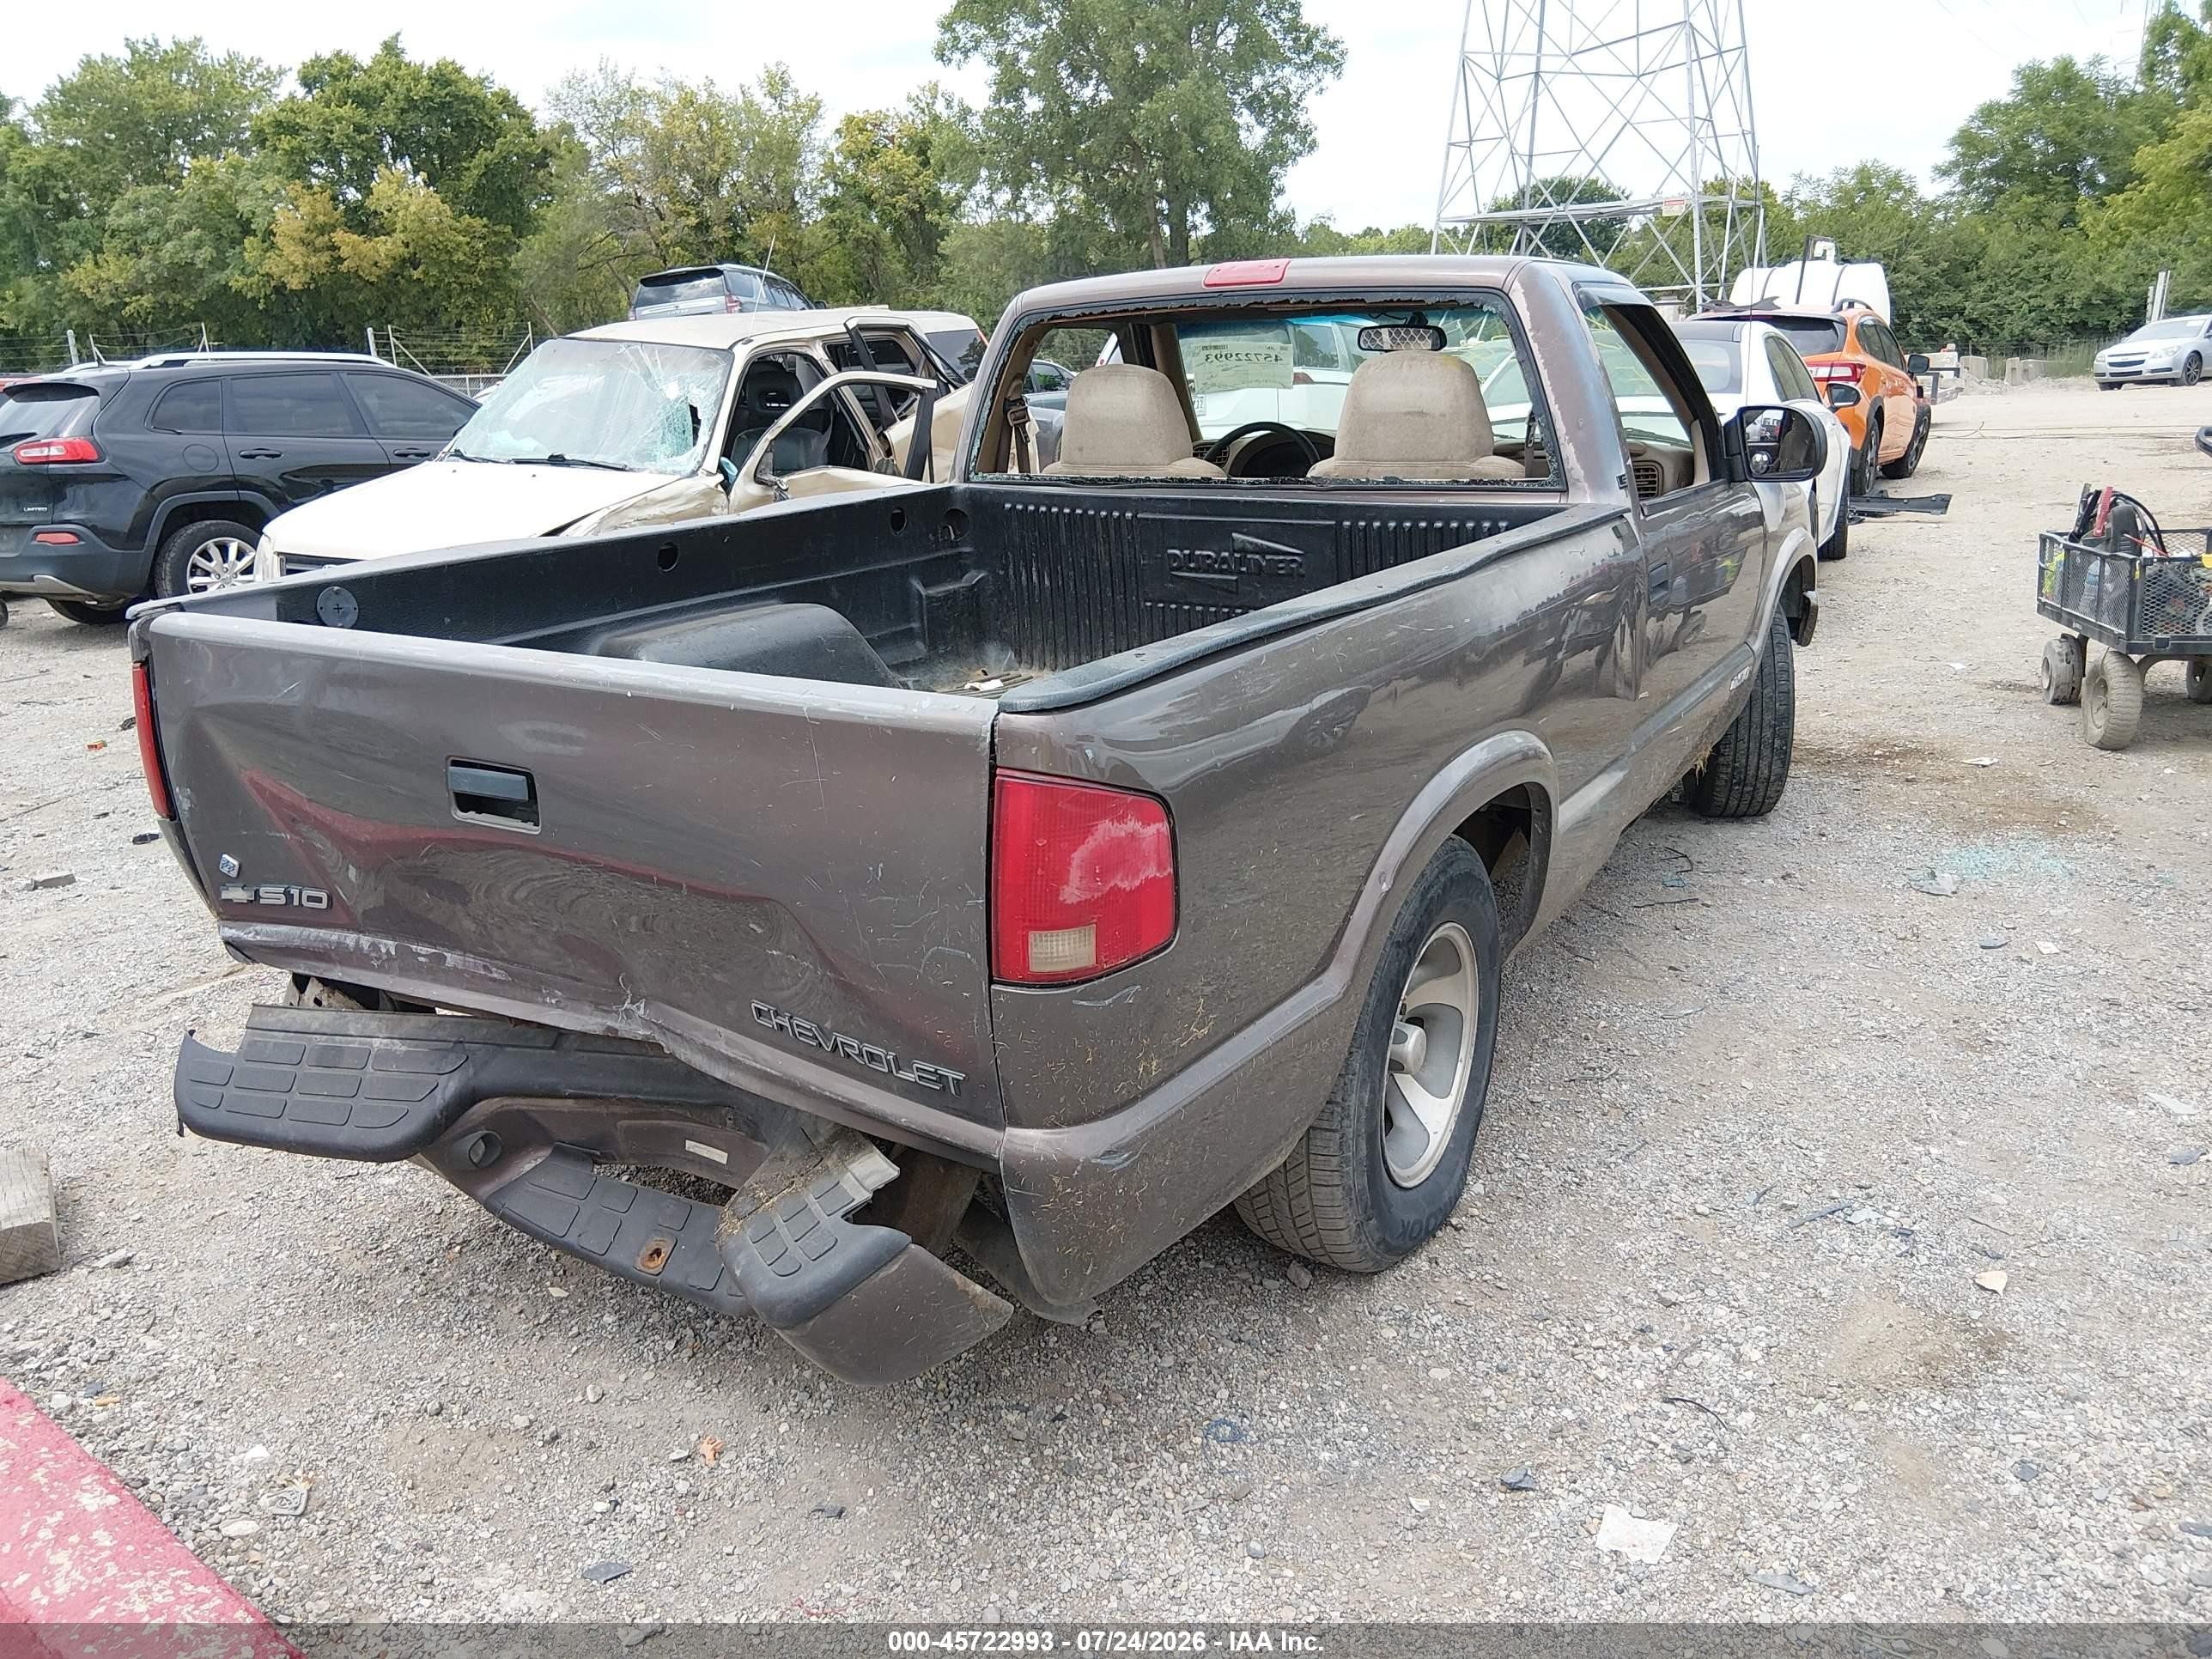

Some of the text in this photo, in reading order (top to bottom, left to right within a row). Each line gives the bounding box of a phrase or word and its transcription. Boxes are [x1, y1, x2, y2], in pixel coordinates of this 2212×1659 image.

[1167, 550, 1306, 577] DURALINER
[258, 885, 331, 910] S10
[750, 1000, 968, 1097] CHEVROLET
